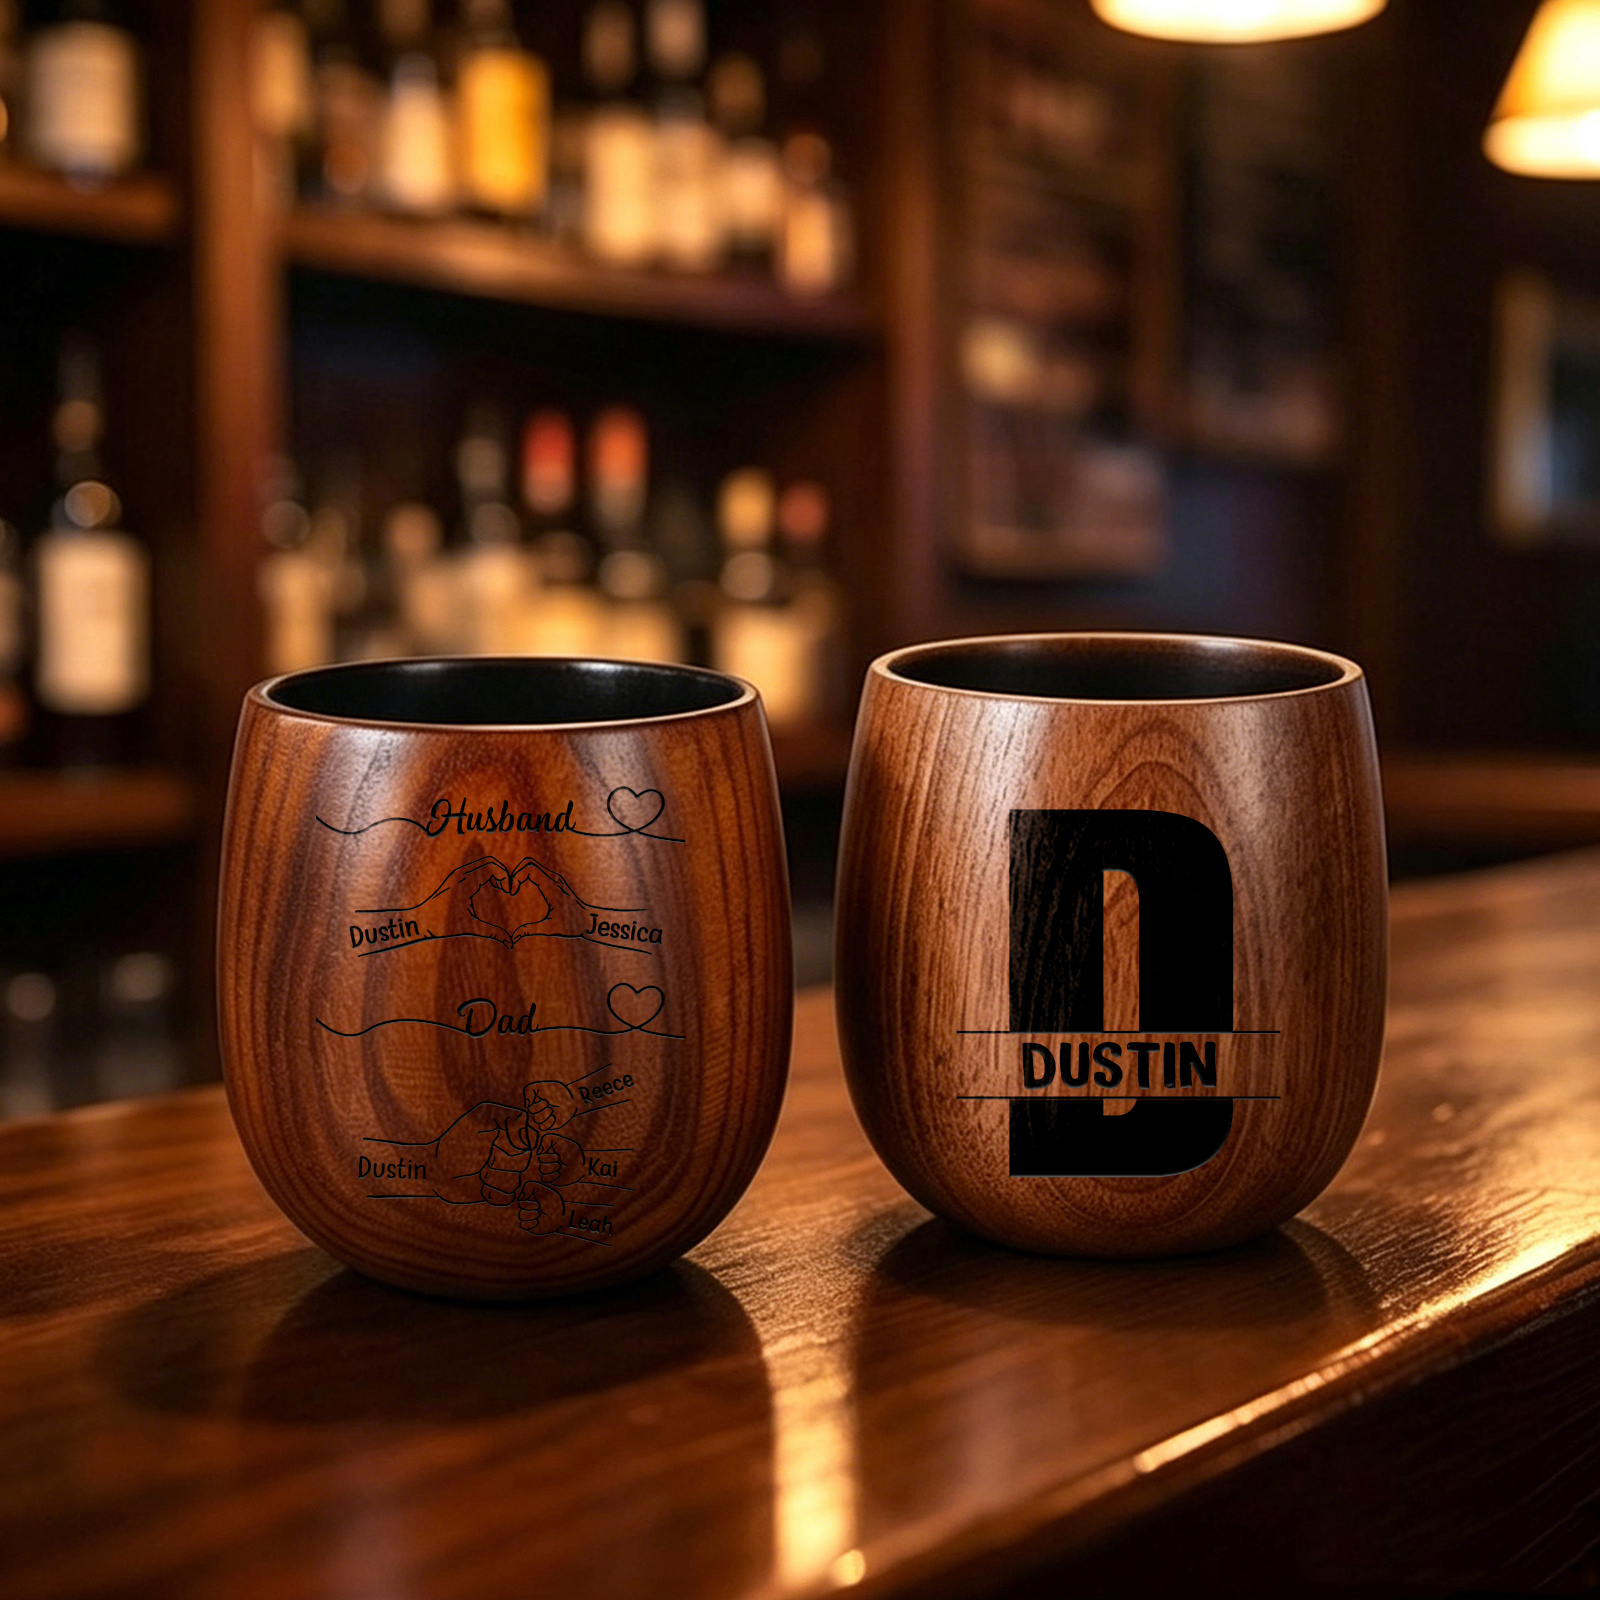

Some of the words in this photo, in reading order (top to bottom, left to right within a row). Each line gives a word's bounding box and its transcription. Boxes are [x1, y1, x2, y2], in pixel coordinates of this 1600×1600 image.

[426, 797, 576, 837] Husband
[349, 918, 420, 948] Dustin
[585, 913, 663, 945] Jessica
[457, 998, 539, 1038] Dad
[1022, 1041, 1217, 1090] DUSTIN
[578, 1074, 634, 1104] Reece
[358, 1156, 427, 1180] Dustin
[588, 1157, 618, 1178] Kai
[569, 1210, 613, 1235] Leah
